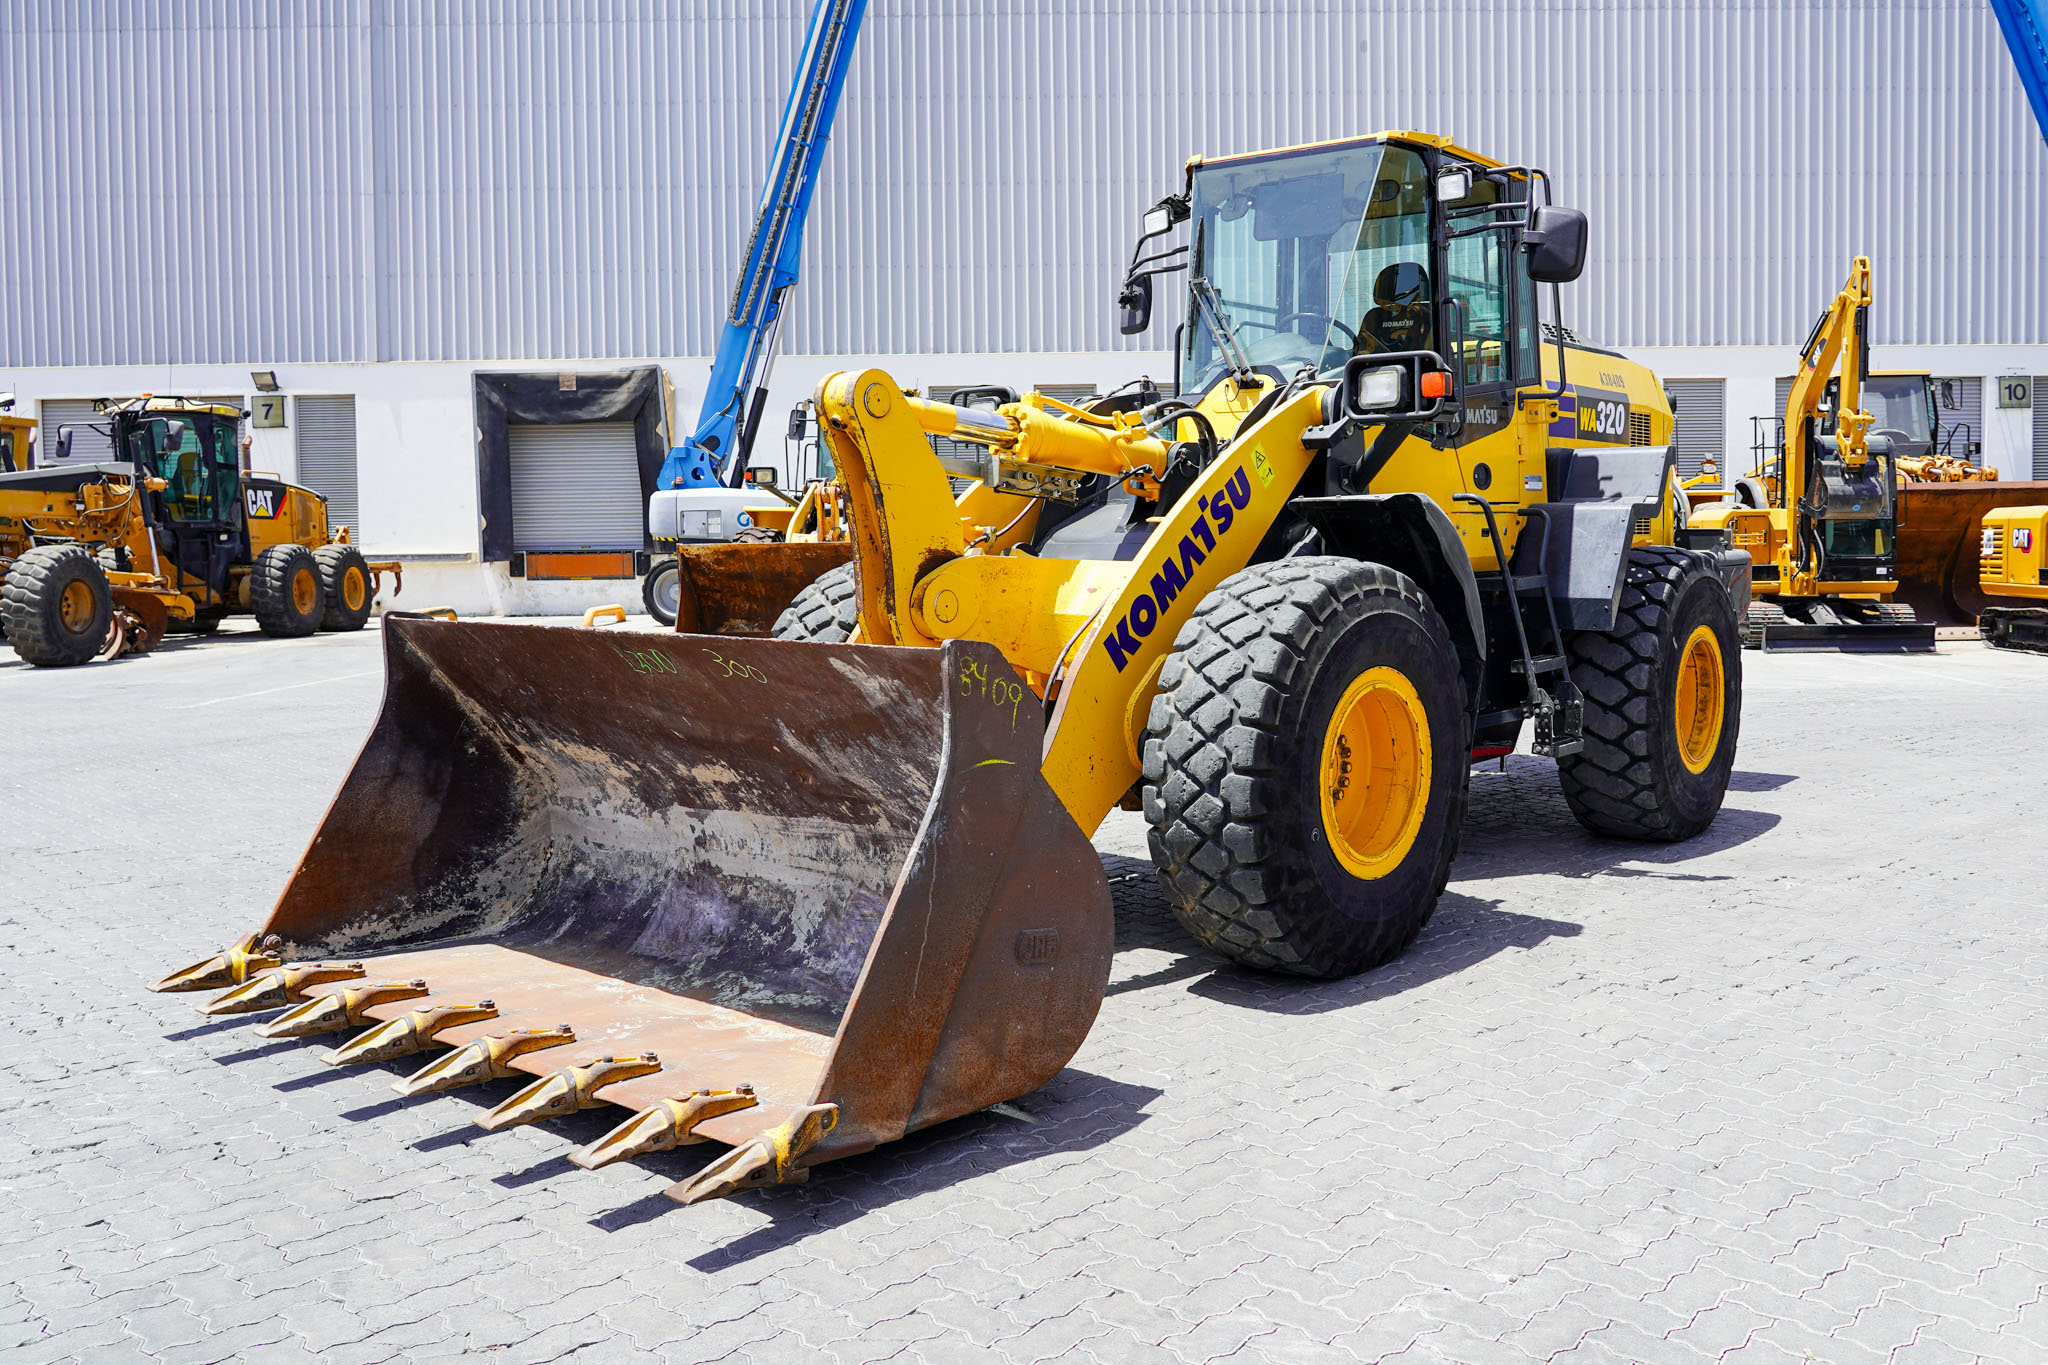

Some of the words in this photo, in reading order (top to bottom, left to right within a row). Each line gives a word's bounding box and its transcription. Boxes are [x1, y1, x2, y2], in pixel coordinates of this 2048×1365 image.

[1382, 319, 1414, 328] KOMATSU
[2004, 383, 2026, 401] 10
[261, 403, 274, 420] 7
[1580, 401, 1625, 435] WA320
[247, 488, 274, 517] CAT
[2012, 528, 2030, 550] CAT
[1102, 465, 1251, 674] KOMATSU
[702, 648, 767, 683] 300
